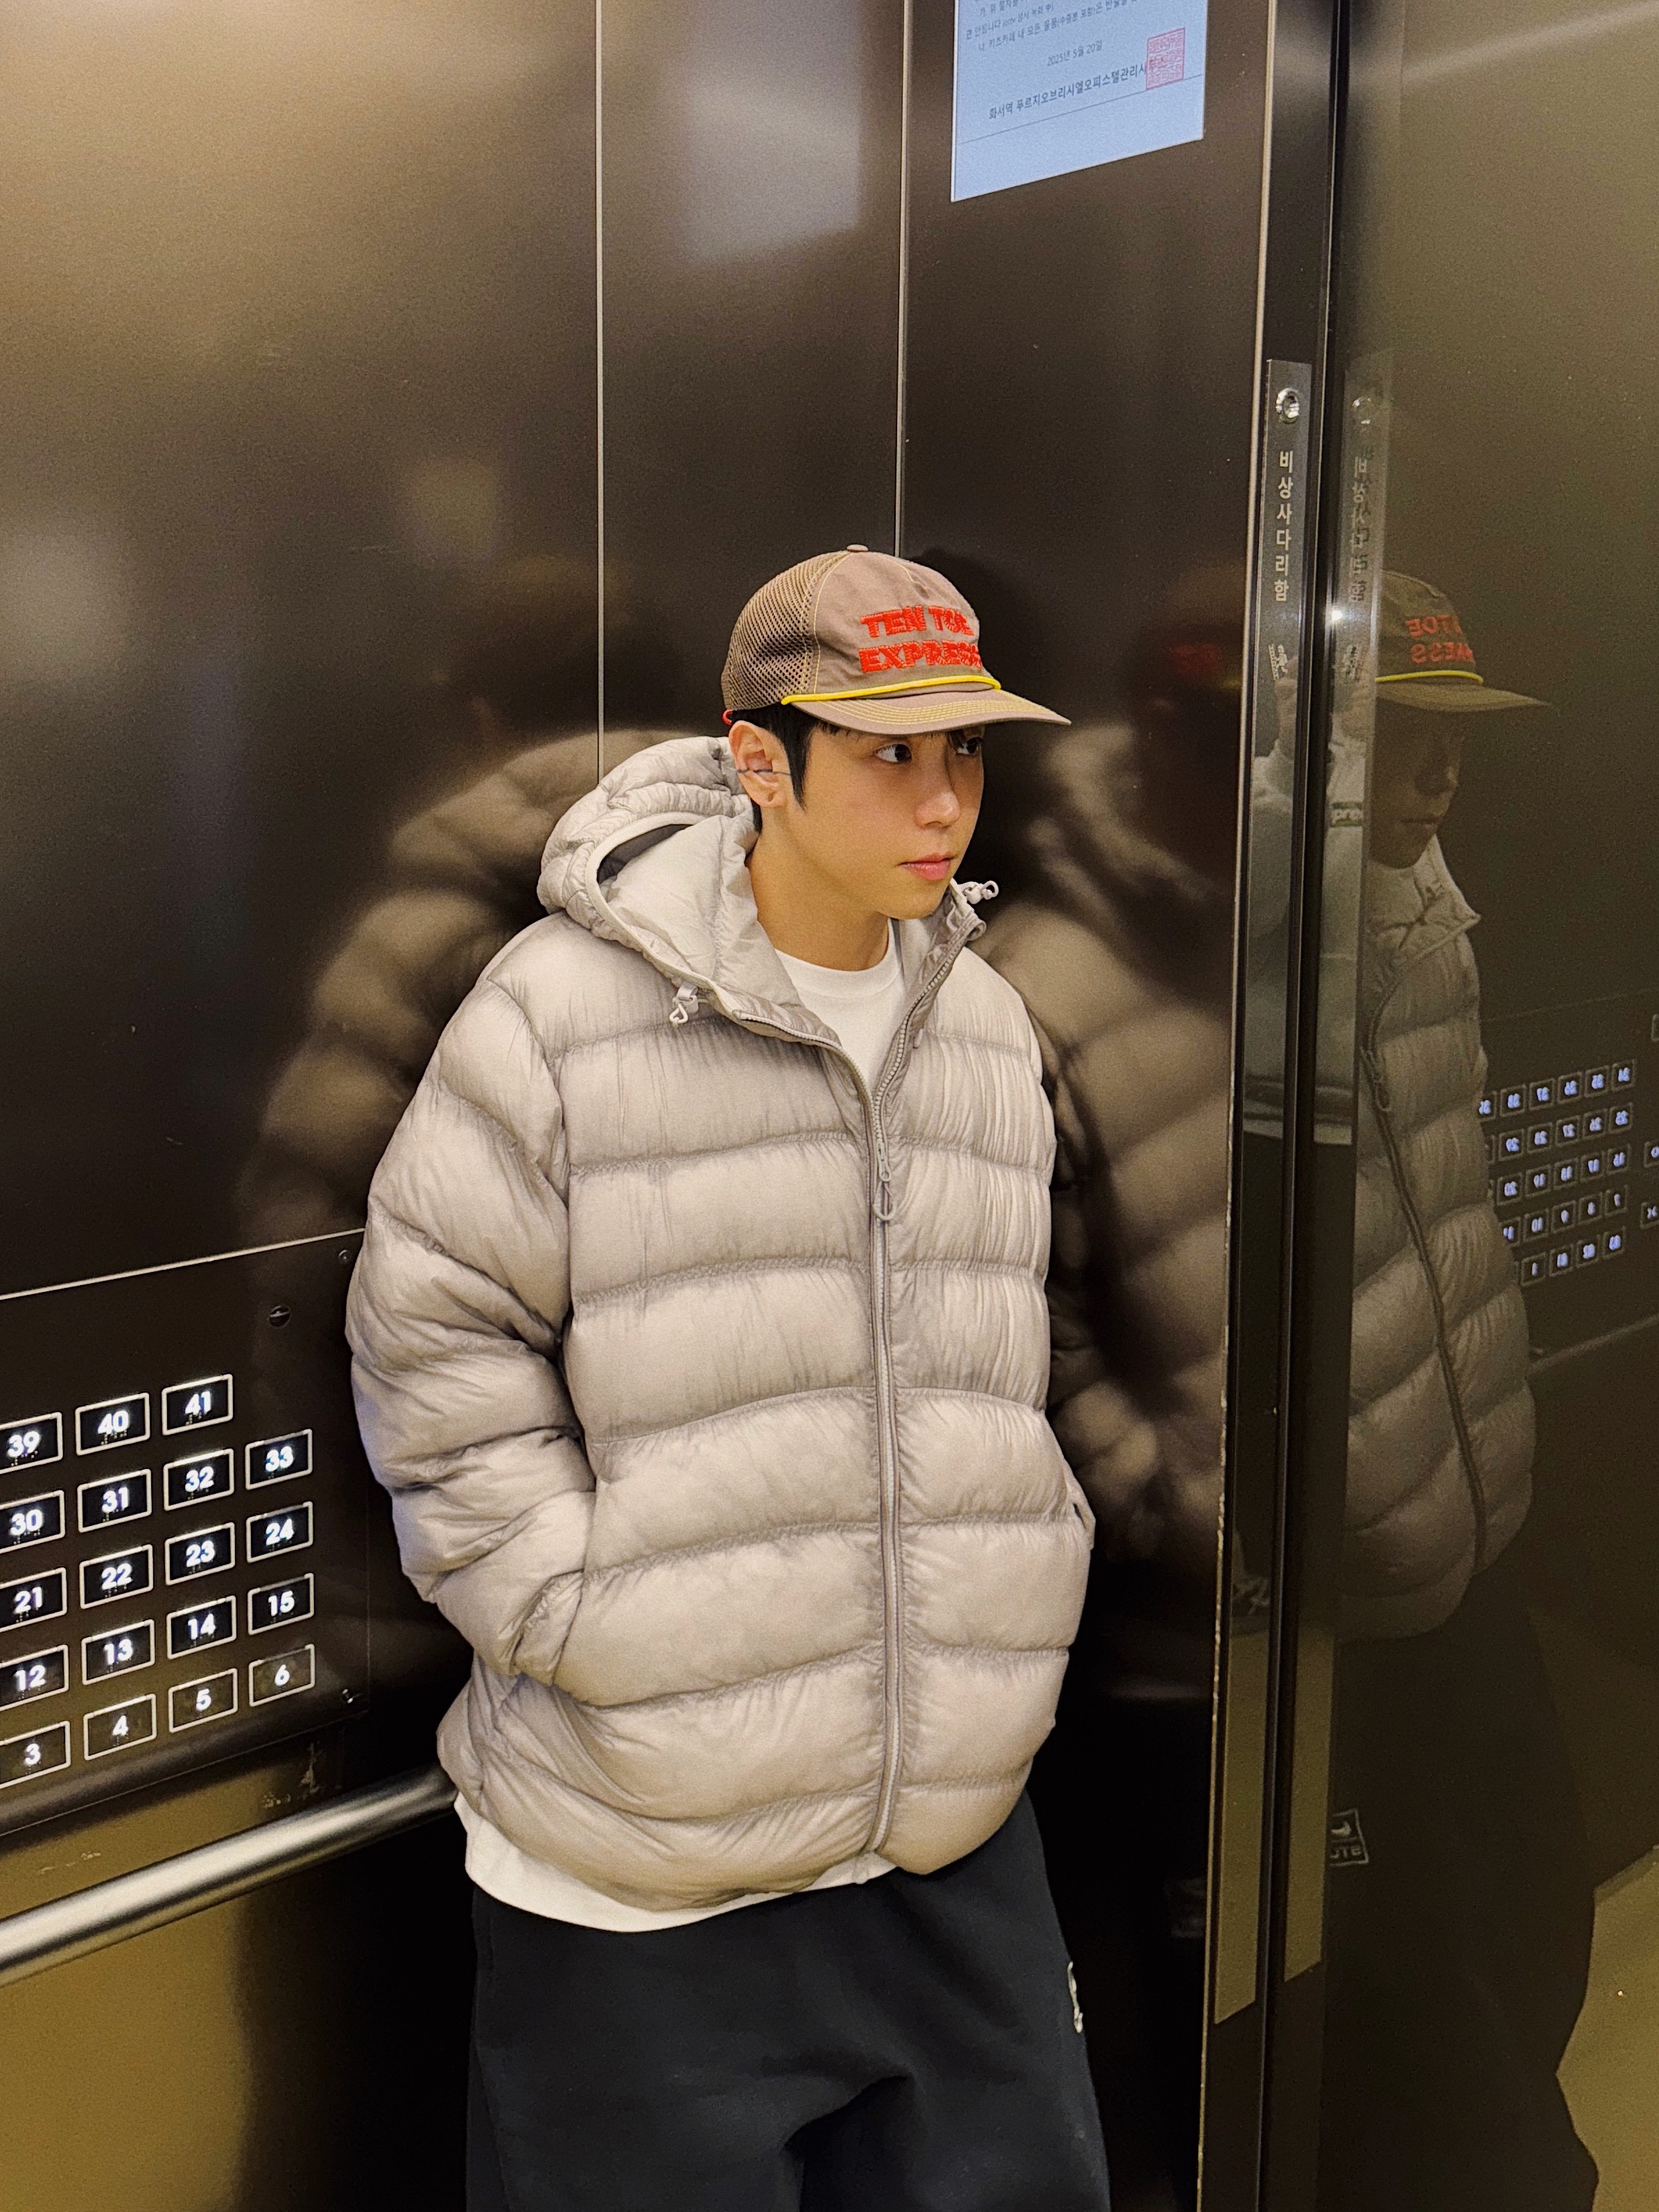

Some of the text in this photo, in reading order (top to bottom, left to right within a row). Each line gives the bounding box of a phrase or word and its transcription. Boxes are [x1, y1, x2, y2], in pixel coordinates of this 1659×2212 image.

[1047, 40, 1102, 67] 2025년 5월 20일
[989, 102, 1014, 120] 화서역
[1274, 451, 1294, 602] 비상사다리함
[858, 639, 982, 674] EXPRESS
[860, 605, 927, 638] TEN
[7, 1391, 211, 1458] 39 40 41
[10, 1445, 294, 1536] 30 31 32 33
[15, 1518, 294, 1614] 21 22 23 24
[15, 1590, 295, 1692] 12 13 14 15
[24, 1664, 290, 1766] 3 4 5 6
